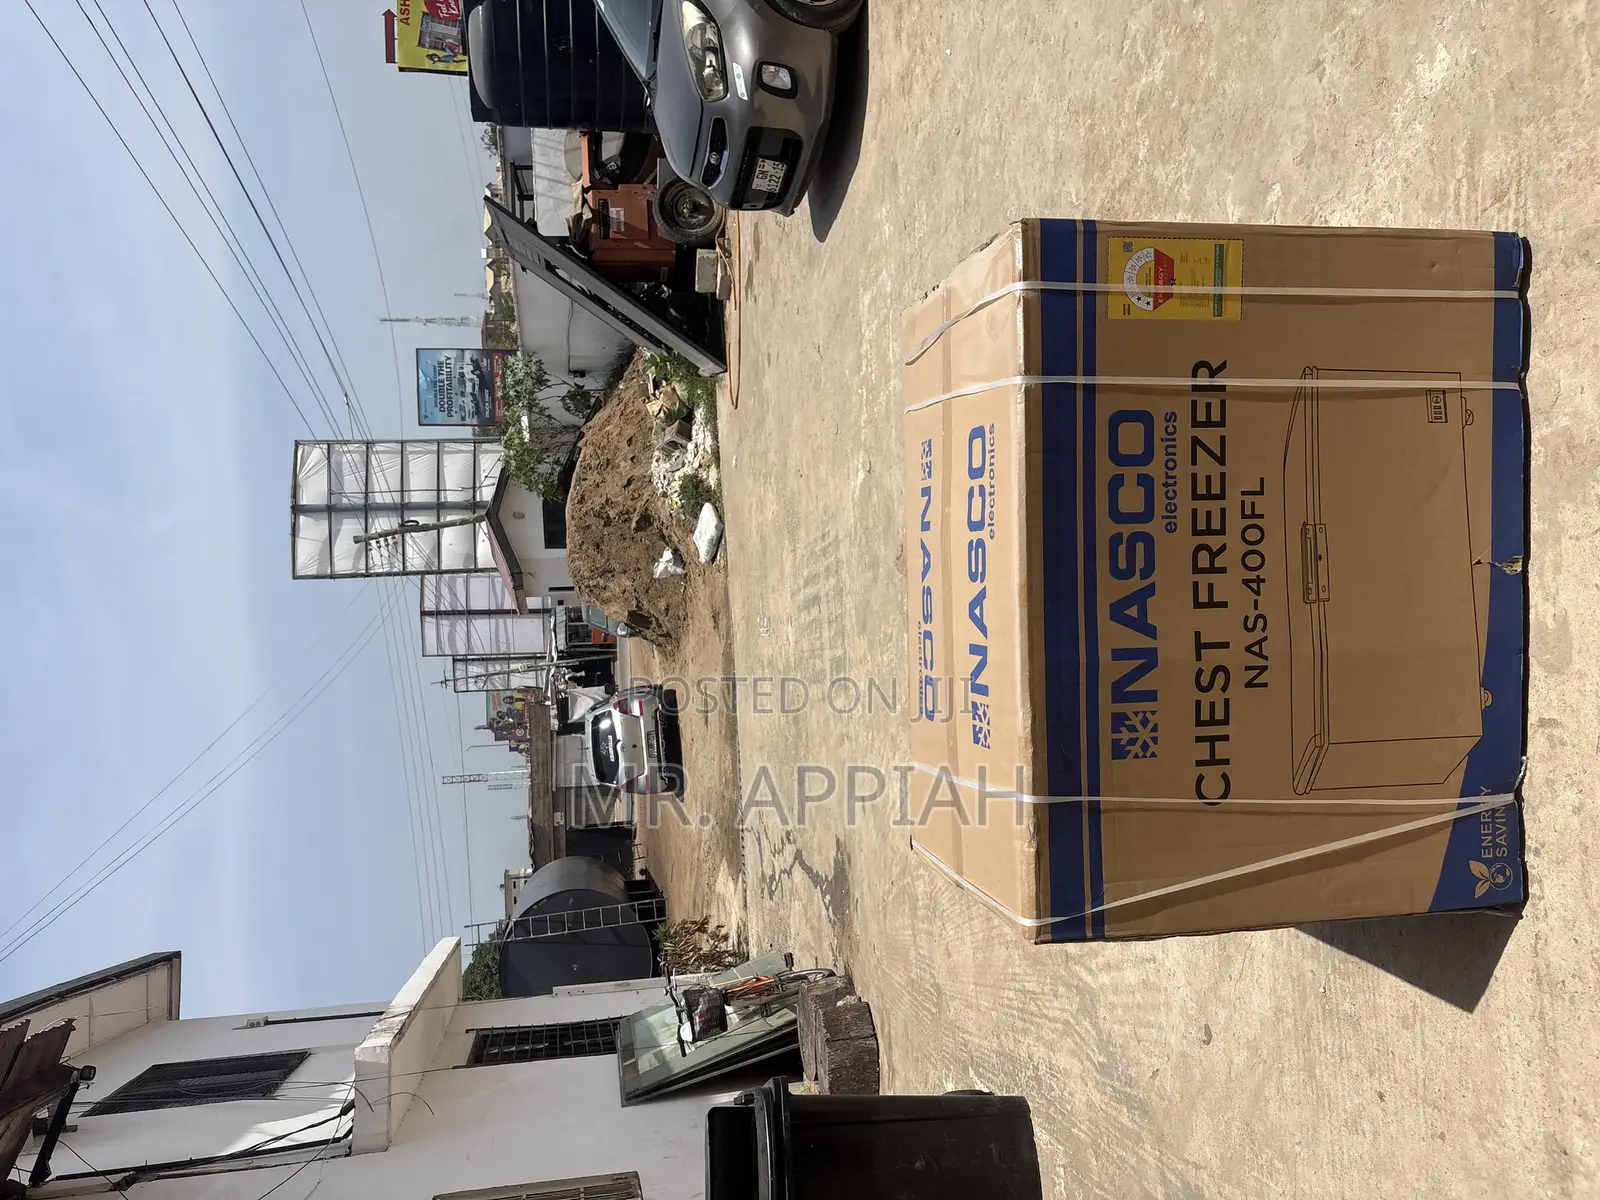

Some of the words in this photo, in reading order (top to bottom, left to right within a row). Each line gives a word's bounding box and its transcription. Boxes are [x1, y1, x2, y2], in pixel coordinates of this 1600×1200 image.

[437, 360, 445, 377] THE
[438, 379, 446, 412] DOUBLE
[445, 355, 453, 418] PROFITABILITY
[988, 423, 996, 540] electronics
[1161, 411, 1178, 533] electronics
[1190, 360, 1228, 609] FREEZER
[921, 485, 935, 722] NASCO
[967, 425, 990, 697] NASCO
[1108, 410, 1158, 704] NASCO
[1241, 477, 1269, 688] NAS-400FL
[1194, 631, 1231, 806] CHEST
[1480, 785, 1493, 858] ENERY
[1495, 793, 1508, 858] SAVIN
